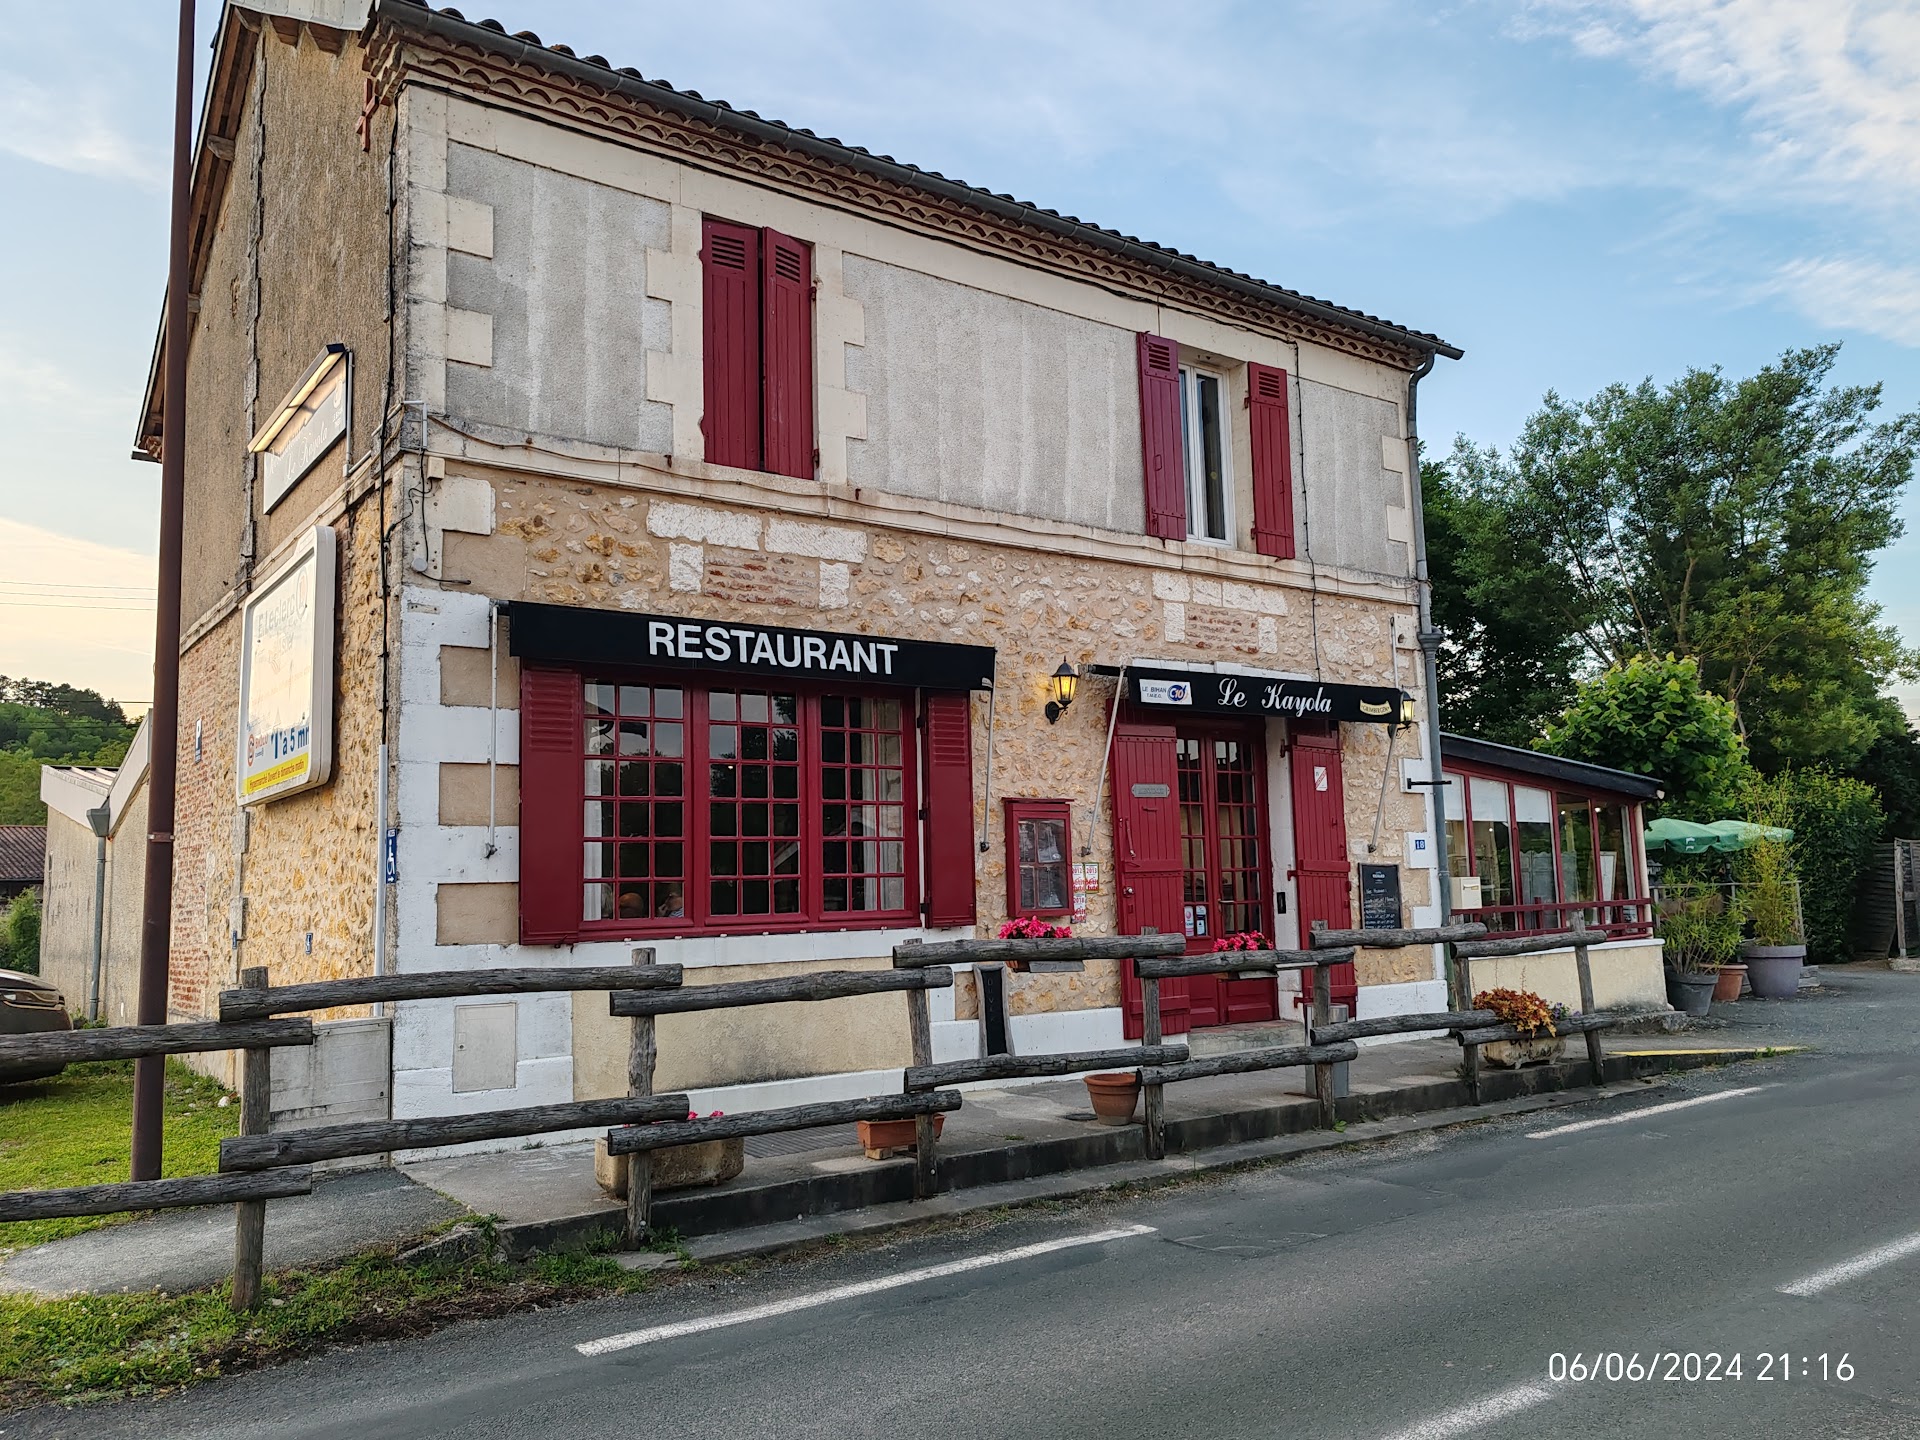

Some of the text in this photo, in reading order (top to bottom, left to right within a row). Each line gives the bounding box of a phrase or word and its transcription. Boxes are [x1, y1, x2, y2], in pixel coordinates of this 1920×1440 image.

[648, 621, 898, 675] RESTAURANT
[1217, 678, 1332, 718] Le Kayola
[282, 731, 288, 756] à
[290, 727, 296, 752] 5
[1415, 840, 1425, 850] 18
